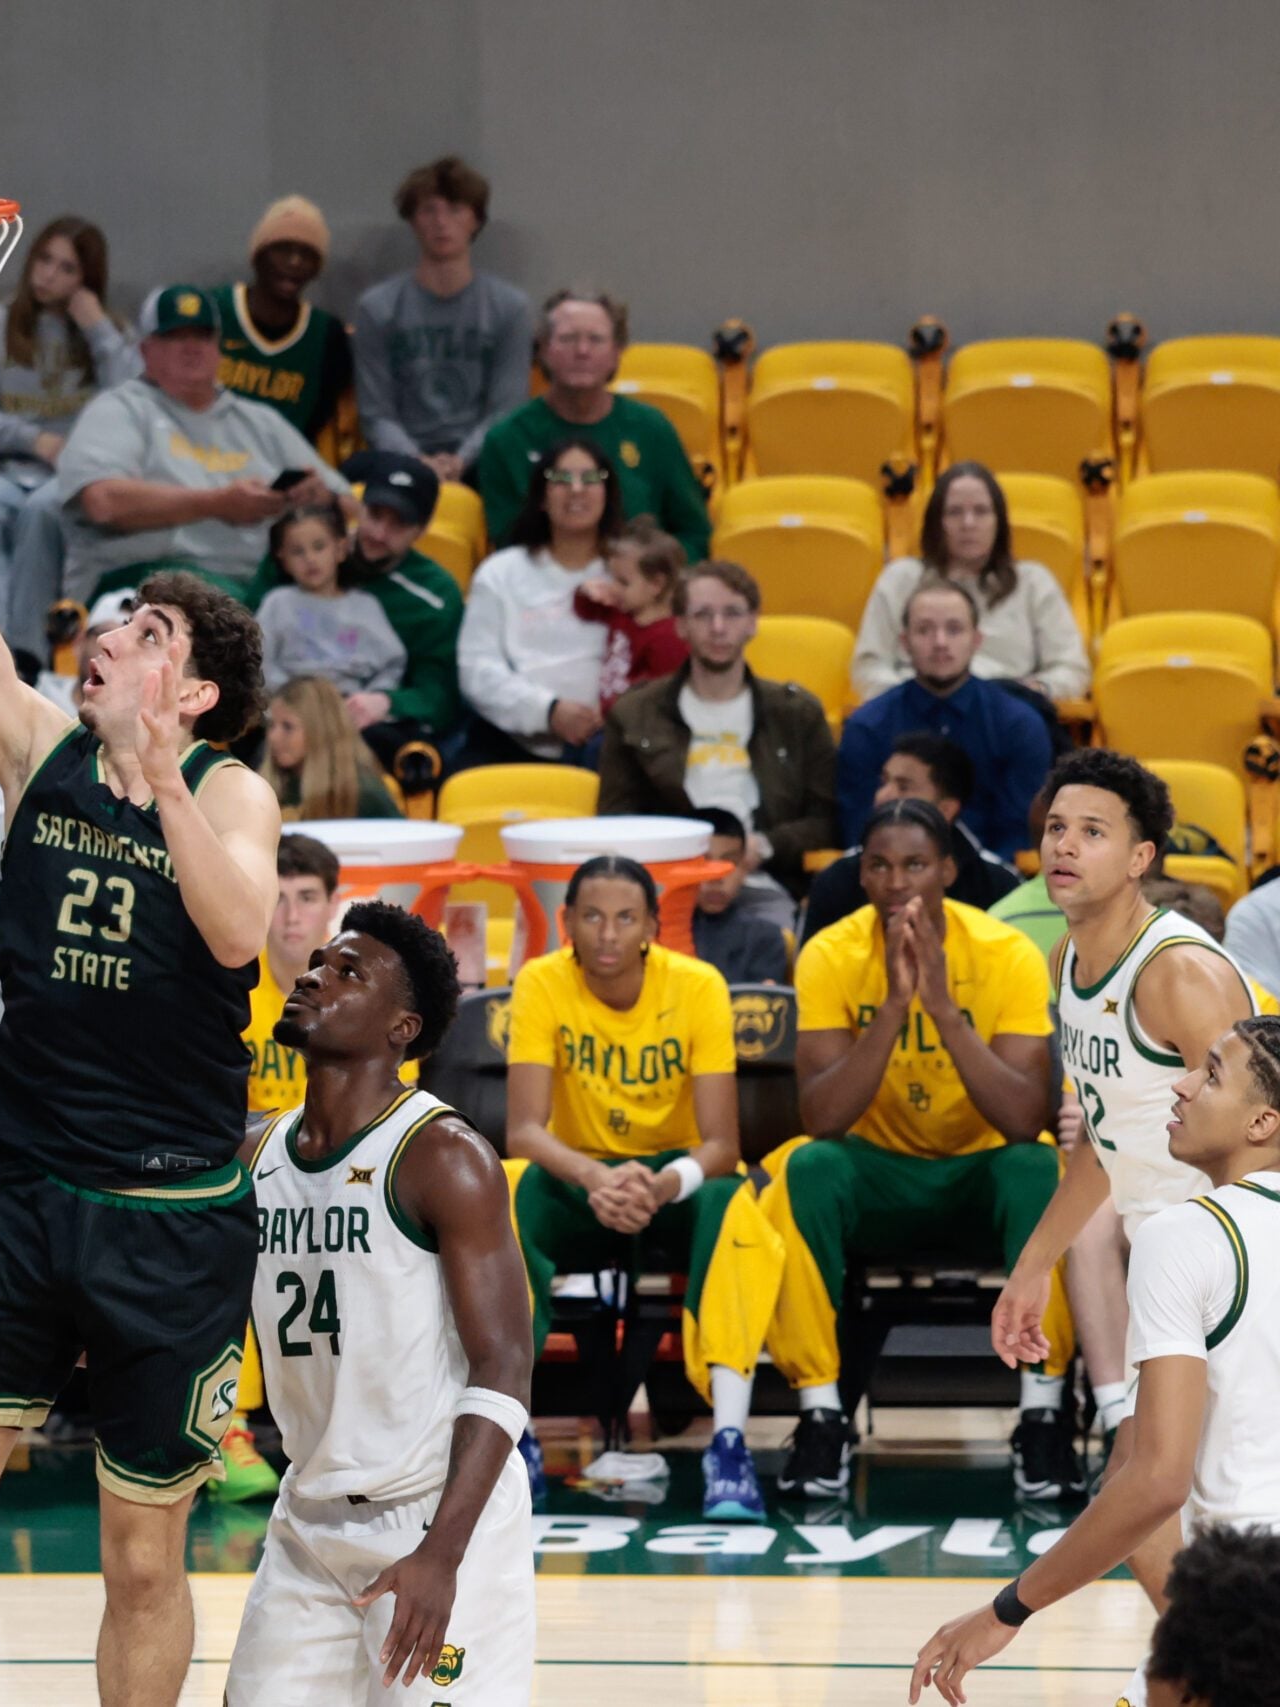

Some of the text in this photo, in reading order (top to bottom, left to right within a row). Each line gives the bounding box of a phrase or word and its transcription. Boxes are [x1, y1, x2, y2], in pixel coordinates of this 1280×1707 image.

[57, 868, 135, 943] 23
[51, 946, 132, 991] STATE
[276, 1270, 341, 1357] 24
